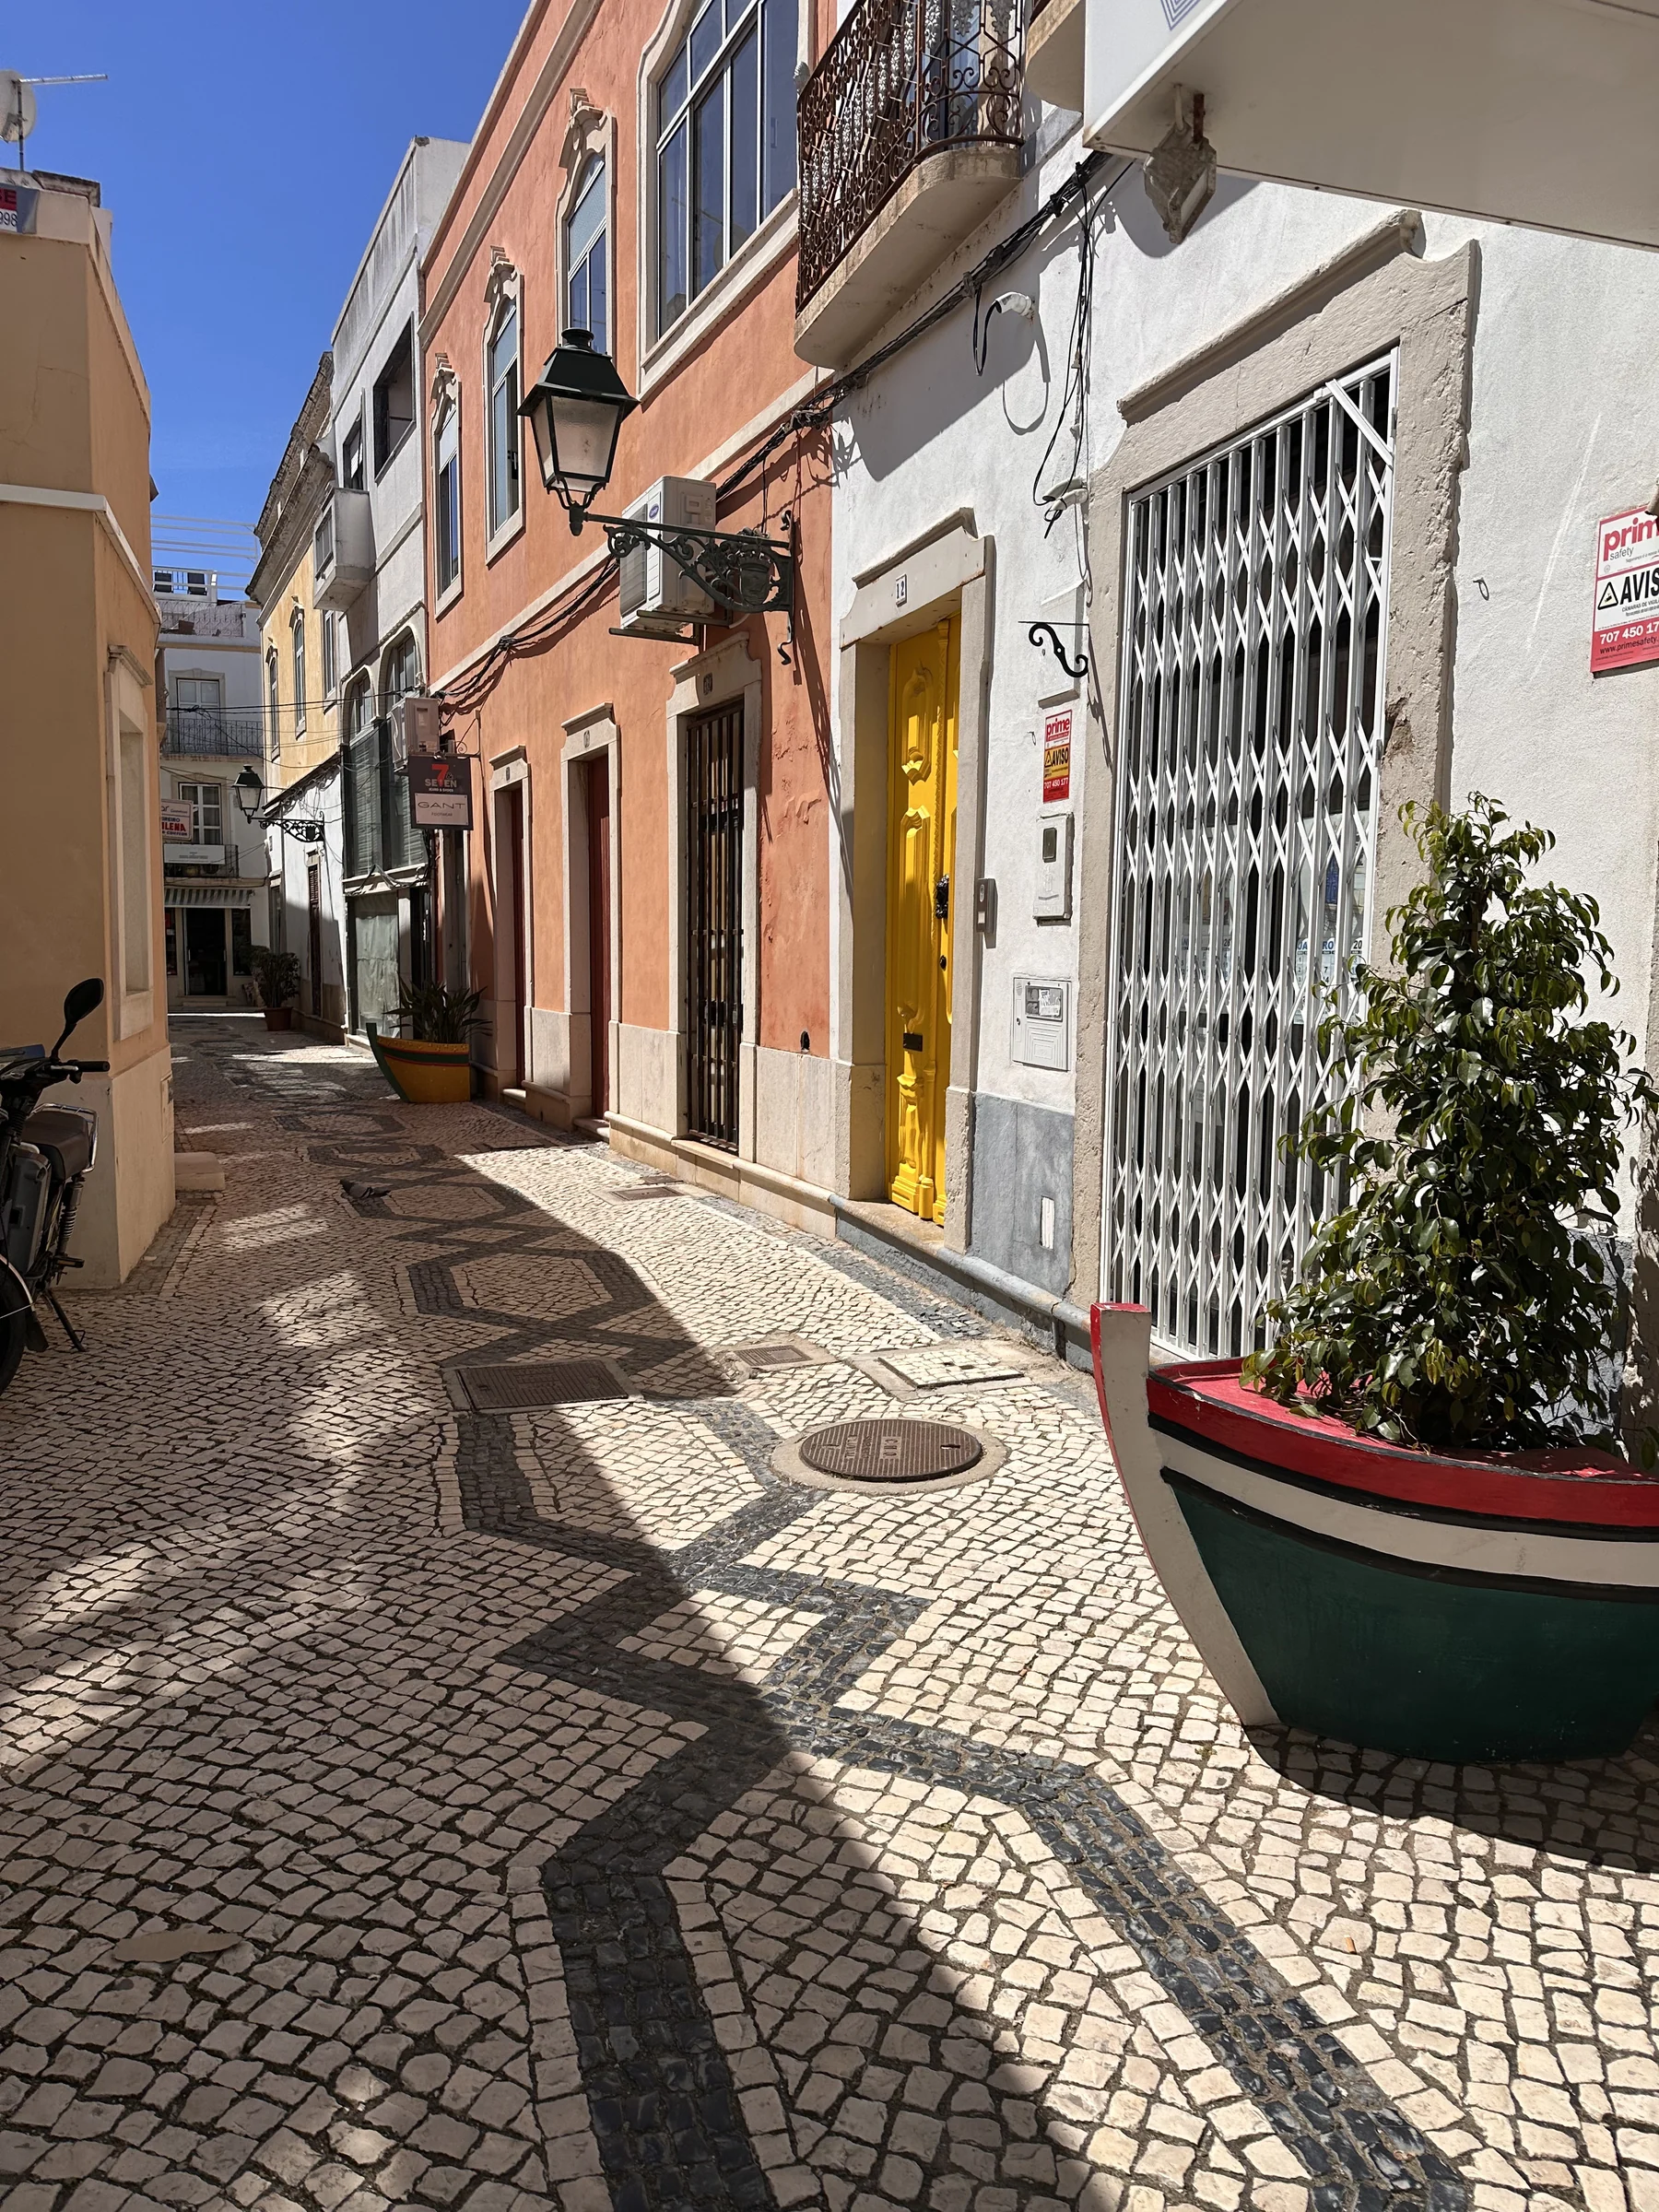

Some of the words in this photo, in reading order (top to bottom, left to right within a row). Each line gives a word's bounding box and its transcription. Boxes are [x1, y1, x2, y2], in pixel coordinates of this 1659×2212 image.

[1610, 547, 1634, 560] safety
[897, 581, 905, 599] 12
[1600, 630, 1619, 644] 707
[1622, 625, 1643, 639] 450
[1046, 718, 1070, 742] prime
[1052, 747, 1068, 766] AVISO
[431, 764, 449, 787] 7
[1052, 779, 1061, 787] 450
[1061, 777, 1069, 786] 177
